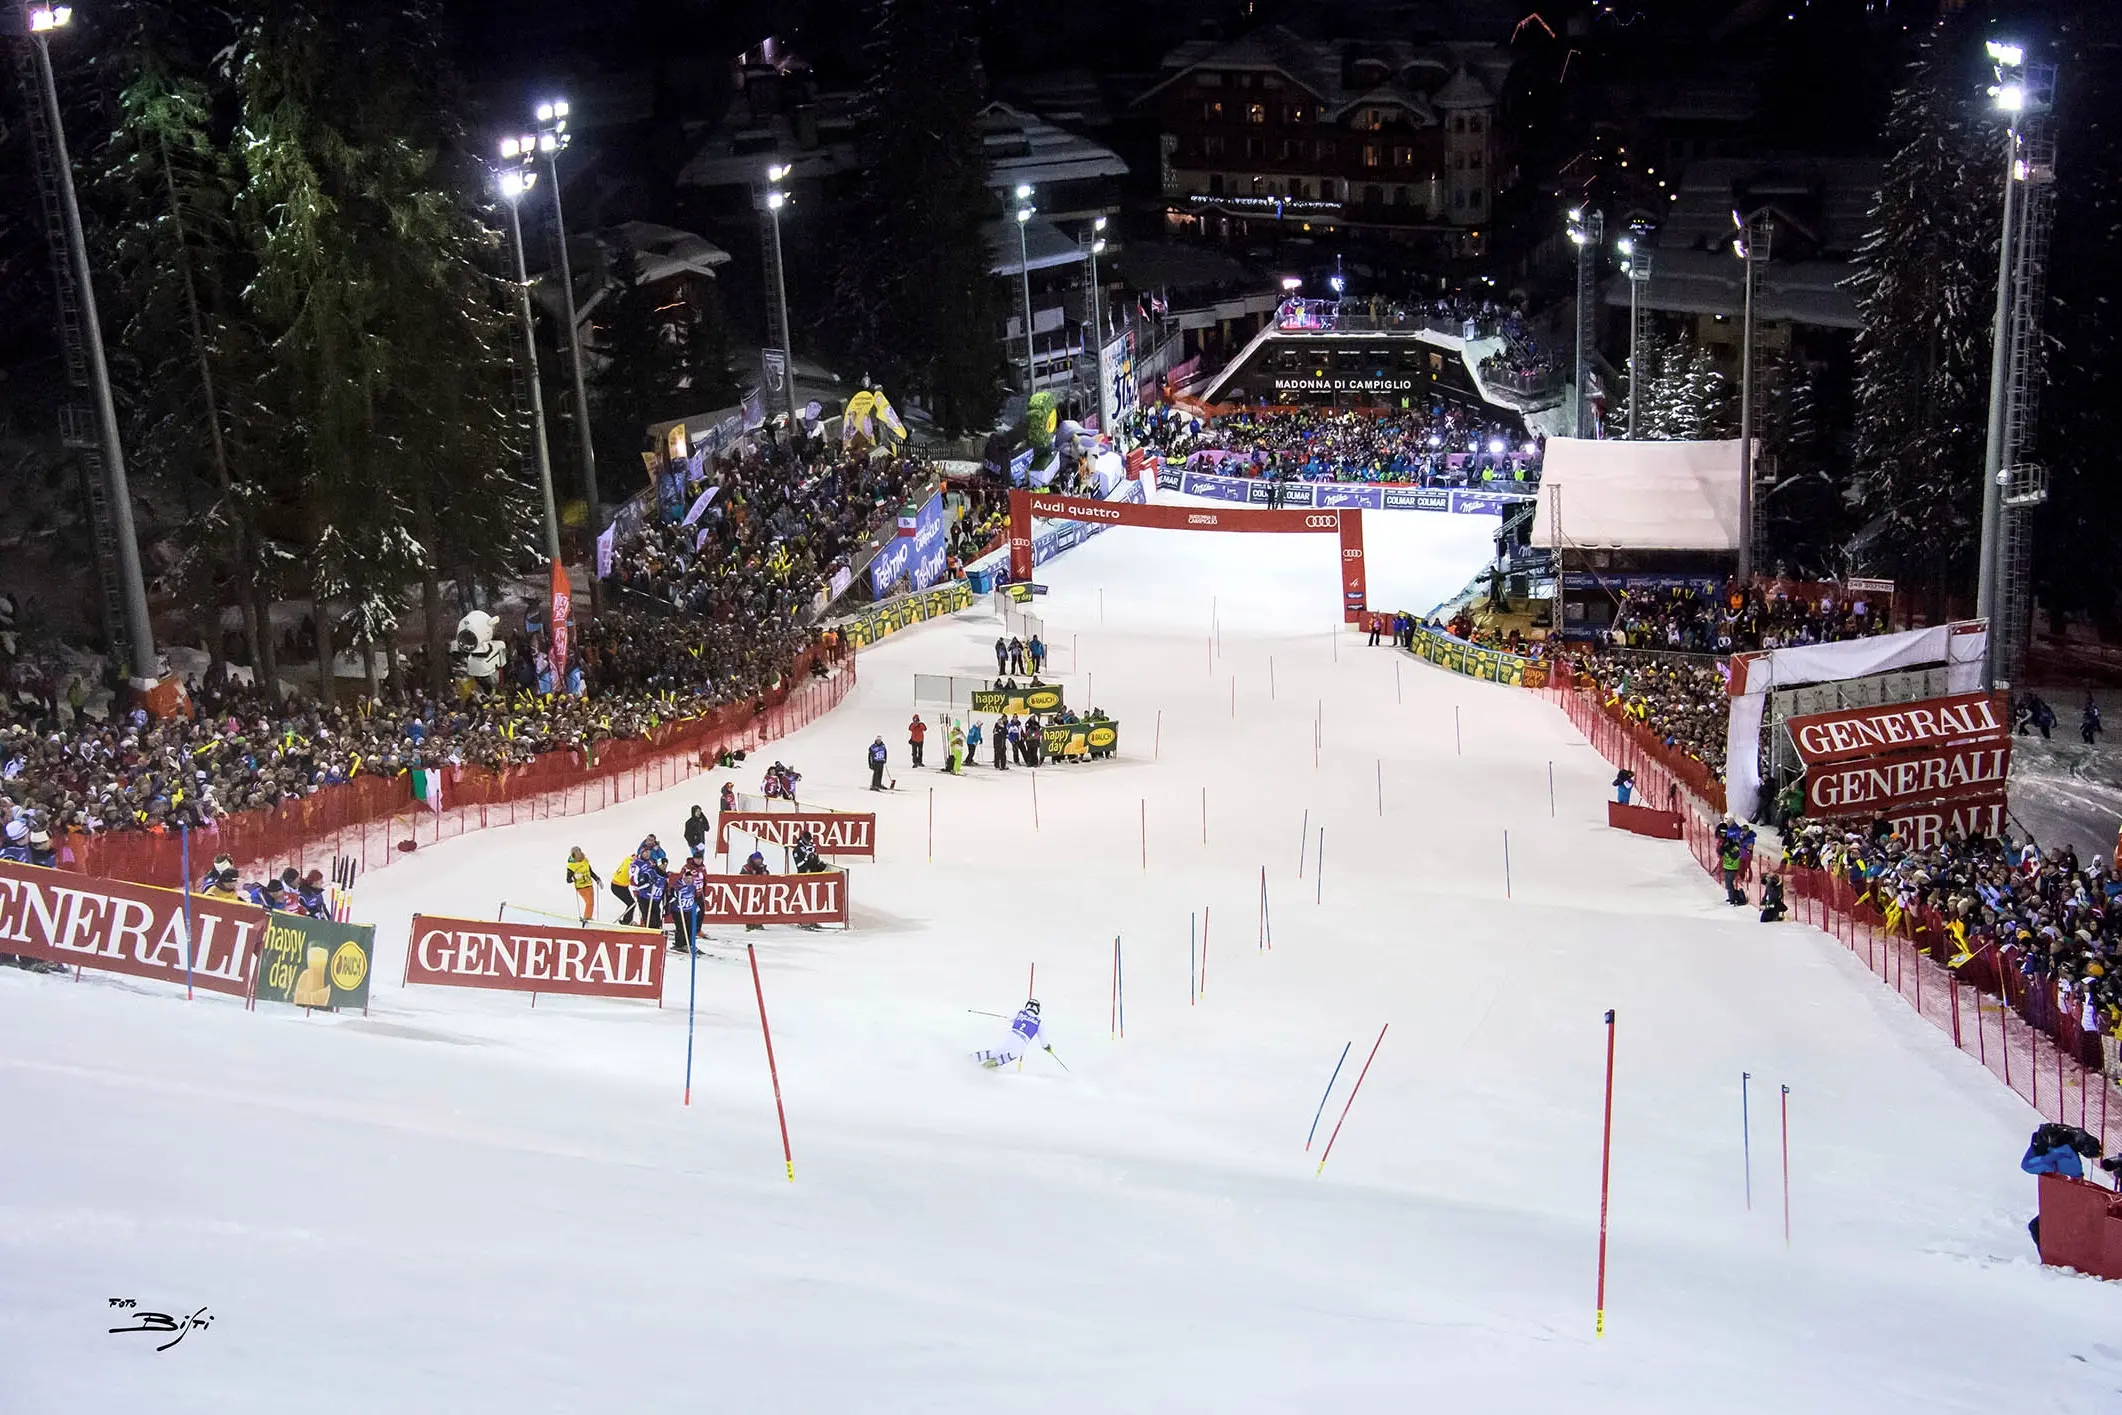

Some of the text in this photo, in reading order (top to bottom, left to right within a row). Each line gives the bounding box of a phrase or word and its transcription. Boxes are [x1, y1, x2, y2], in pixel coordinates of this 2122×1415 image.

[1275, 380, 1412, 389] MADONNA DI CAMPIGLIO
[1157, 475, 1179, 486] LMAR
[1287, 491, 1310, 500] OLMAR
[1386, 496, 1447, 508] COLMAR COLMAR
[1033, 500, 1120, 519] Audi quattro
[975, 693, 1006, 705] happy
[1036, 696, 1055, 704] RAUCH
[982, 704, 1001, 713] day
[1800, 700, 2002, 754] GENERALI
[1043, 729, 1071, 742] happy
[1094, 732, 1112, 741] RAUCH
[1048, 741, 1064, 753] day
[1811, 749, 2006, 807] GENERALI
[1888, 804, 2004, 850] ERALI
[704, 881, 839, 916] ENERALI
[264, 917, 306, 963] happy
[418, 929, 657, 986] GENERALI
[269, 955, 298, 999] day
[1019, 1023, 1027, 1031] 2
